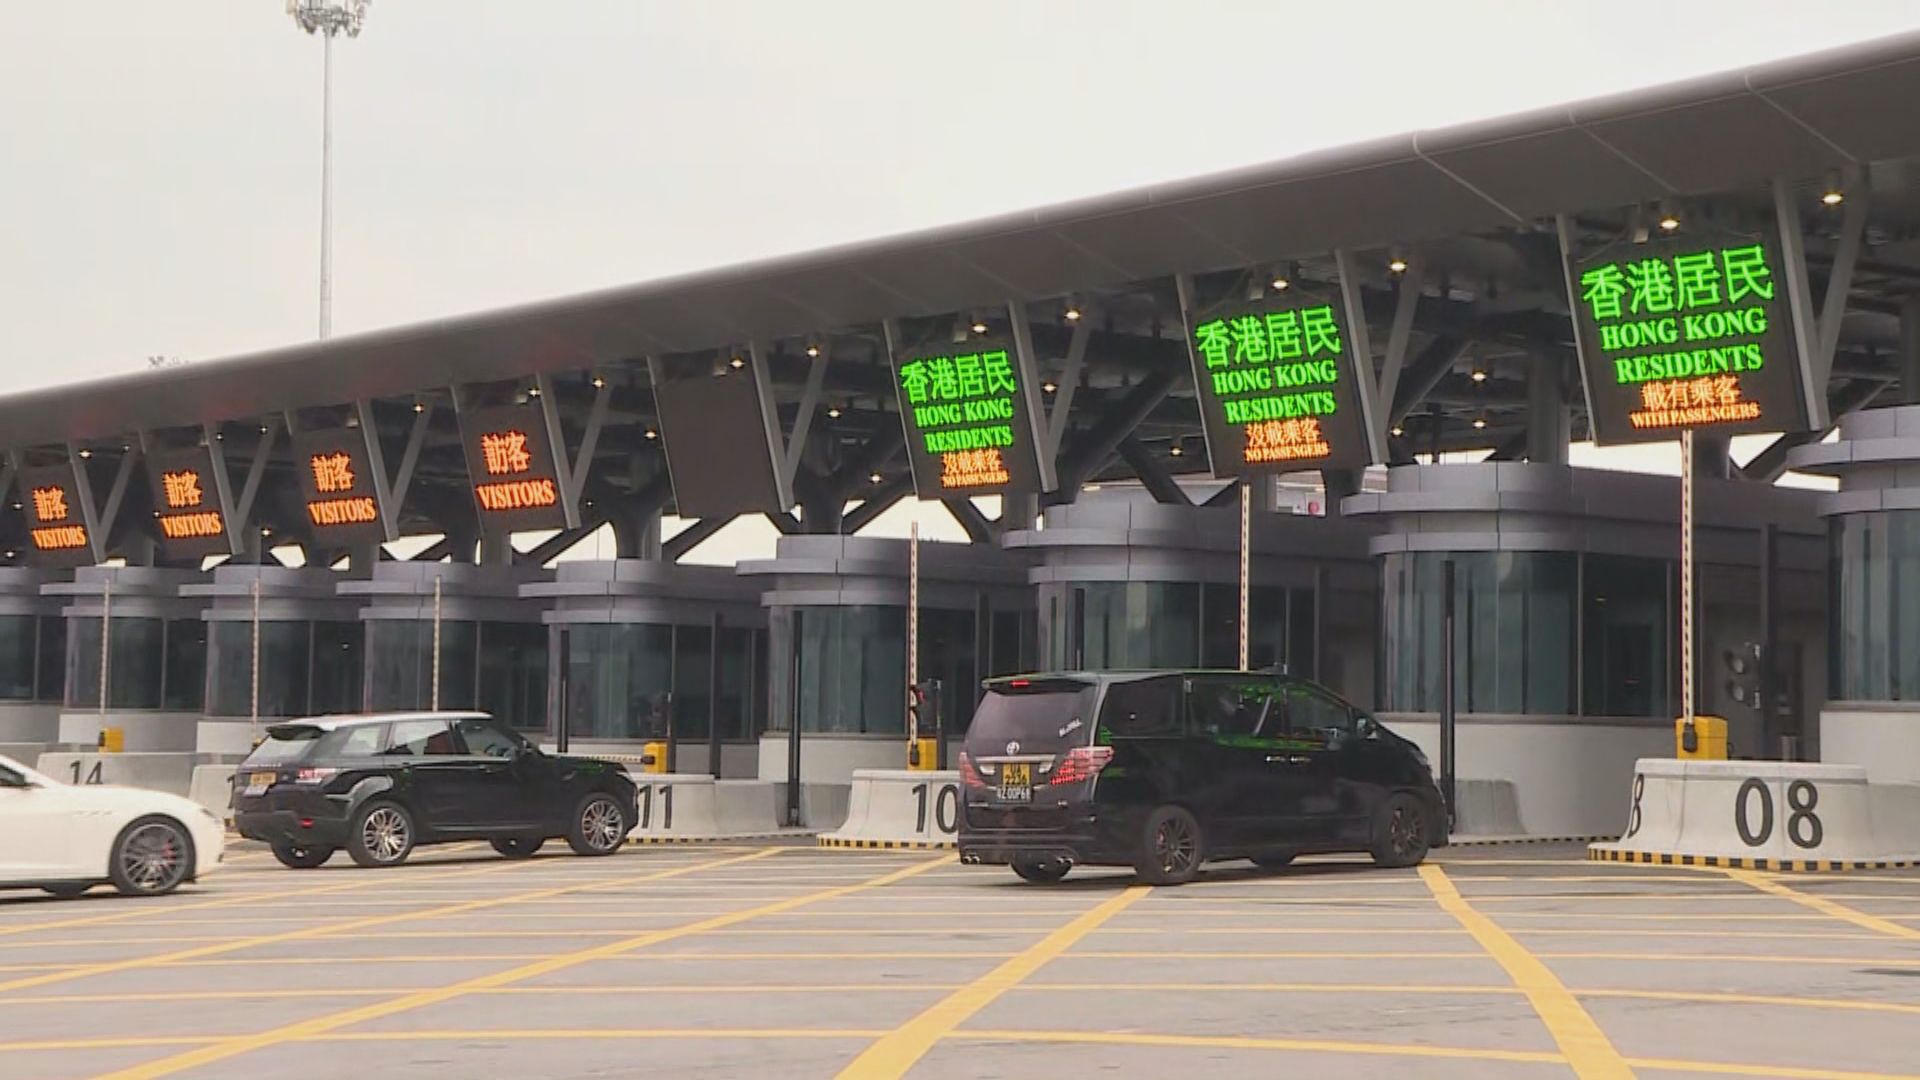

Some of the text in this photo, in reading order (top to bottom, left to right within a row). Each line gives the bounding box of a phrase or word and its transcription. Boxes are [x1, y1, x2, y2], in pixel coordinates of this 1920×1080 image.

[1581, 245, 1773, 319] 香港居民
[1195, 305, 1341, 369] 香港居民
[1600, 307, 1767, 349] HONG KONG
[900, 350, 1016, 404] 香港居民
[1212, 359, 1338, 396] HONG KONG
[1614, 344, 1763, 384] RESIDENTS
[914, 397, 1014, 428] HONG KONG
[1224, 391, 1337, 424] RESIDENTS
[1630, 402, 1761, 428] WITH PASSENGERS
[481, 431, 531, 474] 訪客
[924, 425, 1014, 454] RESIDENTS
[1245, 441, 1330, 462] NO PASSENGERS
[163, 472, 204, 506] 訪客
[311, 454, 356, 491] 訪客
[941, 470, 1009, 488] NO PASSENGERS
[33, 487, 68, 520] 訪客
[308, 498, 376, 524] VISITORS
[476, 479, 556, 510] VISITORS
[31, 526, 87, 548] VISITORS
[160, 512, 222, 537] VISITORS
[70, 760, 103, 785] 14
[638, 784, 673, 830] 11
[912, 783, 958, 834] 10
[1735, 776, 1823, 849] 08
